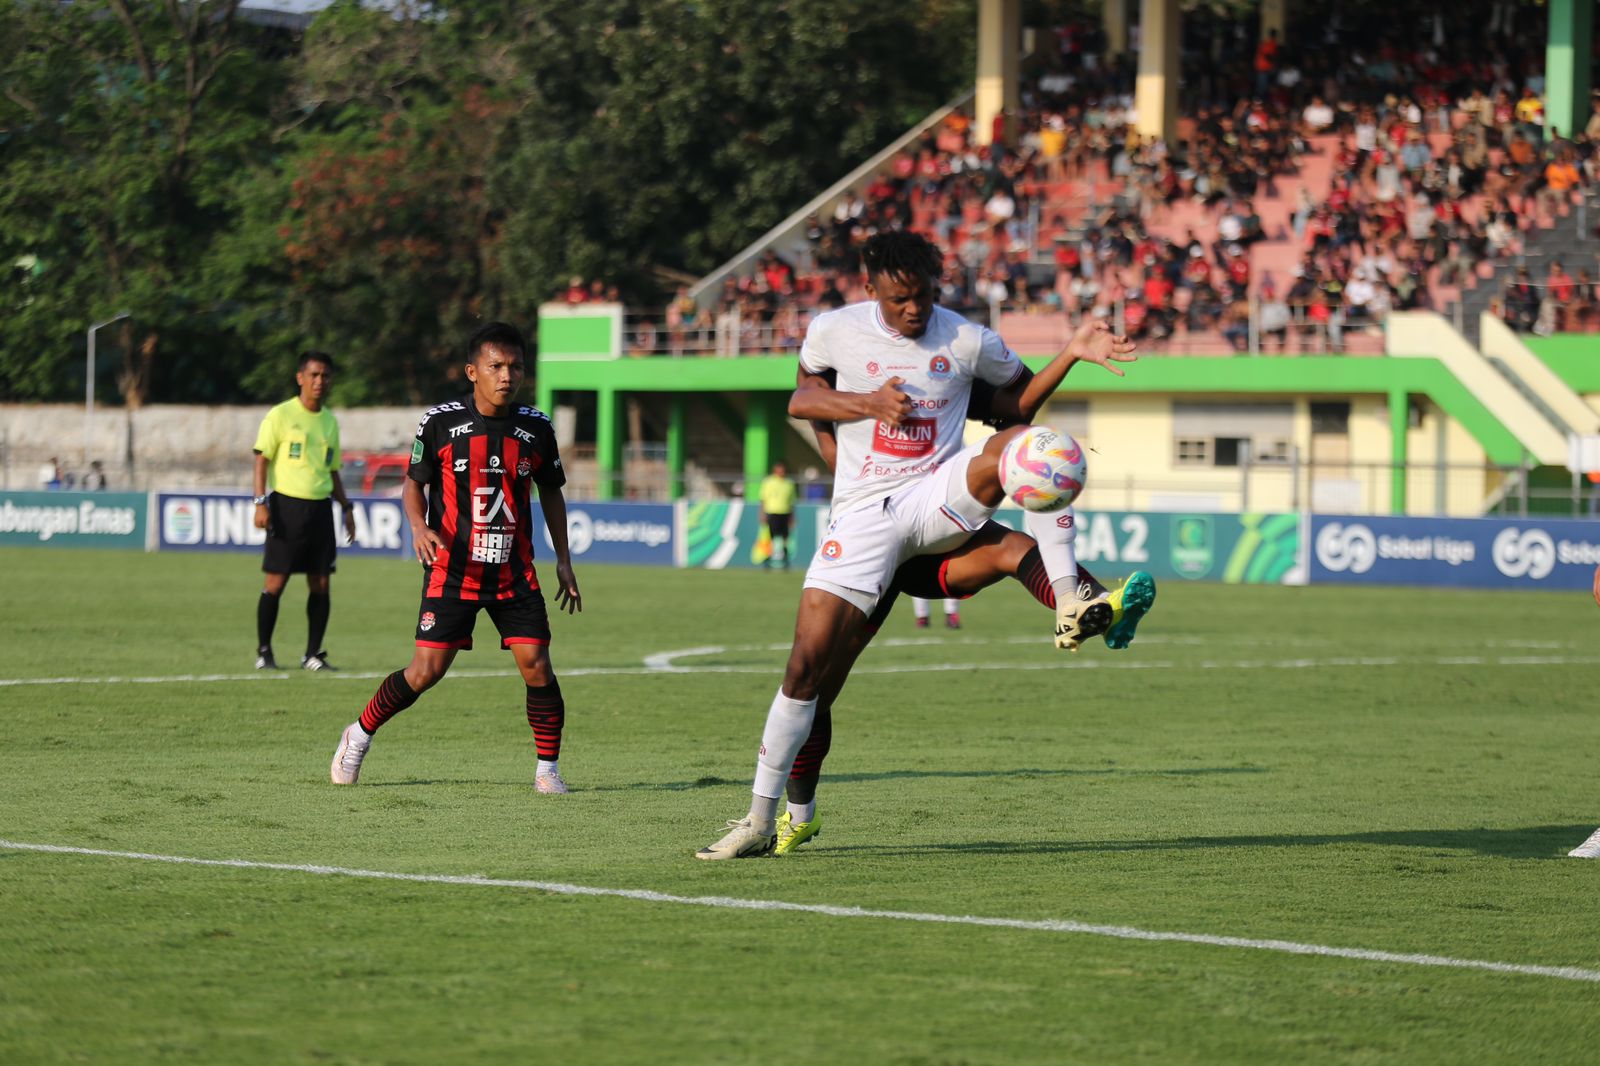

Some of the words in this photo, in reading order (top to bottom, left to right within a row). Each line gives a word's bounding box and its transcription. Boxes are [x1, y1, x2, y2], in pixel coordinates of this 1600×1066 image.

[449, 421, 473, 438] TRC
[513, 426, 535, 443] TRC
[878, 422, 932, 441] SUKUN
[473, 487, 516, 523] EA
[0, 500, 77, 540] bungan
[79, 500, 135, 534] Emas
[1119, 513, 1149, 563] 2
[1557, 540, 1600, 565] Soba
